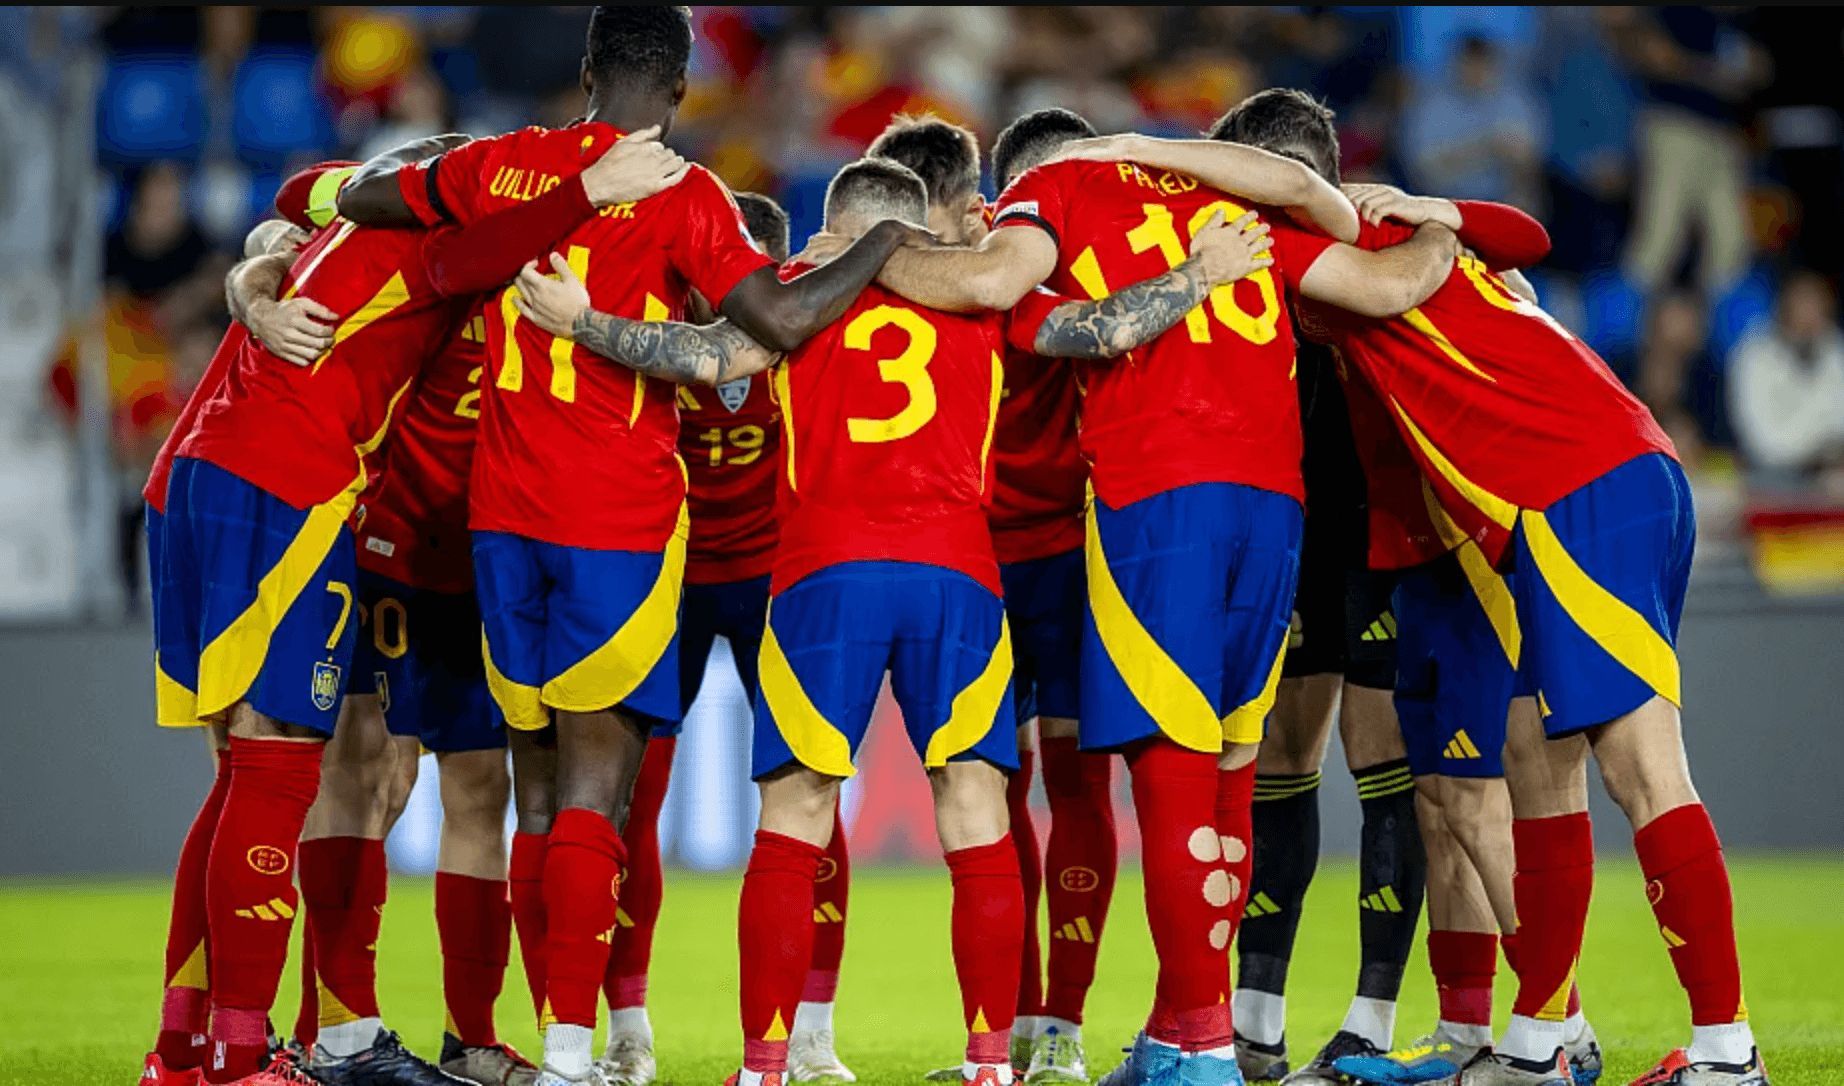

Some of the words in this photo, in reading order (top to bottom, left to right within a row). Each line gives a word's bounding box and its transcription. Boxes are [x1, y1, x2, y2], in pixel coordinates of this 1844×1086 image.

[495, 244, 591, 404] 11
[843, 303, 938, 443] 3
[699, 424, 765, 467] 19
[325, 580, 353, 650] 7
[358, 597, 409, 659] 0
